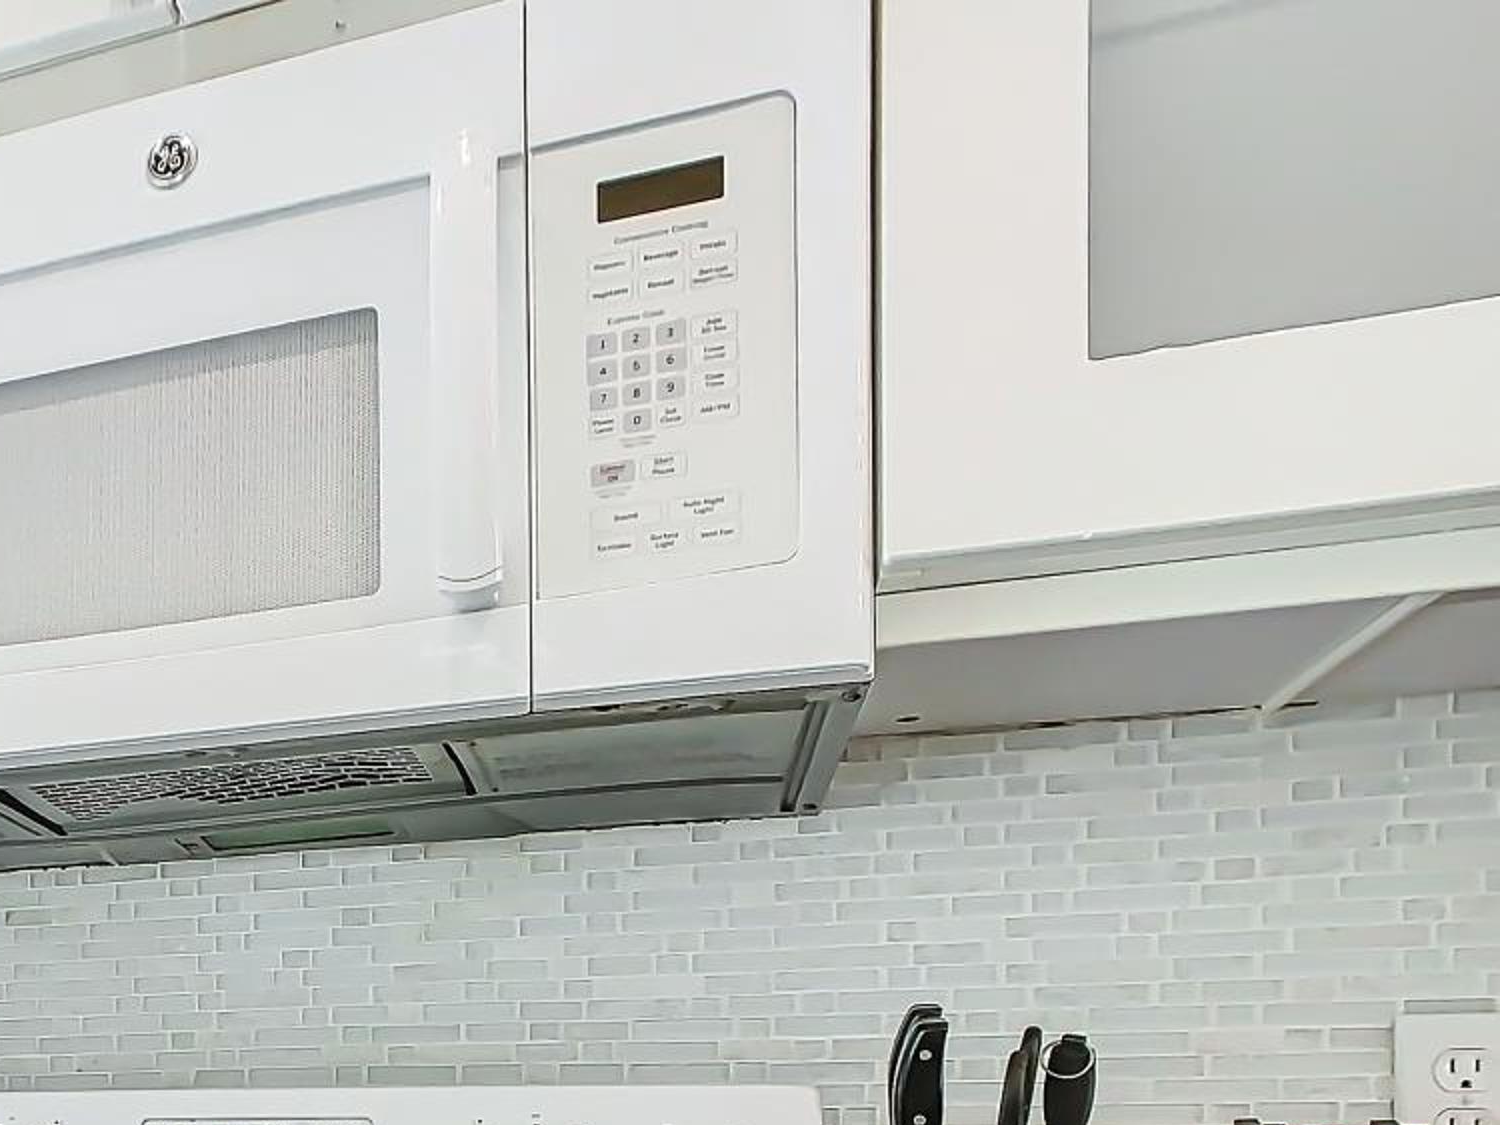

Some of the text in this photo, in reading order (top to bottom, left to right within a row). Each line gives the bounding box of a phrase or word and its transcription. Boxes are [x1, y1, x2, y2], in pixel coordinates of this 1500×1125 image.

[632, 332, 640, 343] 2
[667, 327, 674, 338] 3
[599, 354, 675, 376] 4 5 6
[600, 382, 675, 404] 7 8 9
[633, 415, 641, 425] 0
